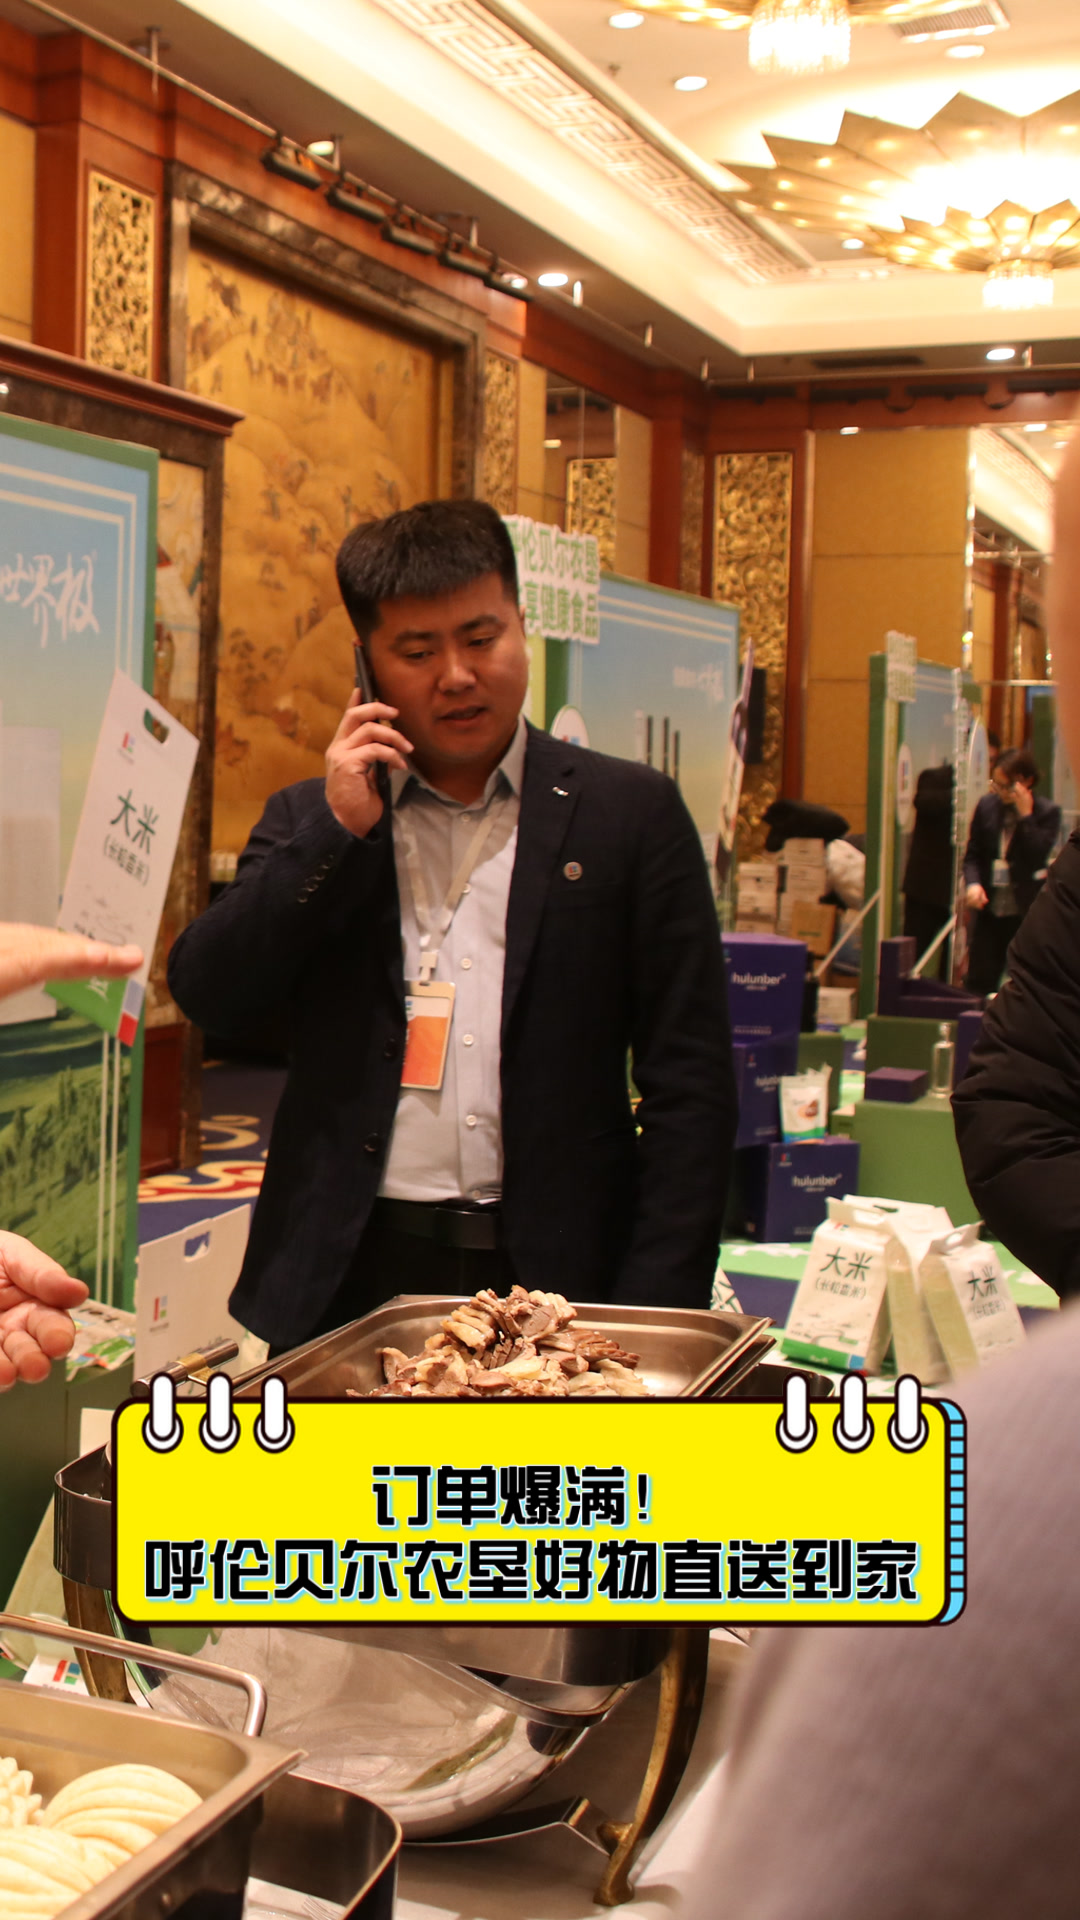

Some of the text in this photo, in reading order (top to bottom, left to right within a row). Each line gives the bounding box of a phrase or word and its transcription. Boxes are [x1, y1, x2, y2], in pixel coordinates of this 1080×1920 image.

[519, 578, 599, 639] 享健康食品
[110, 789, 160, 855] 大米
[819, 1247, 874, 1282] 大米
[967, 1265, 998, 1302] 大米
